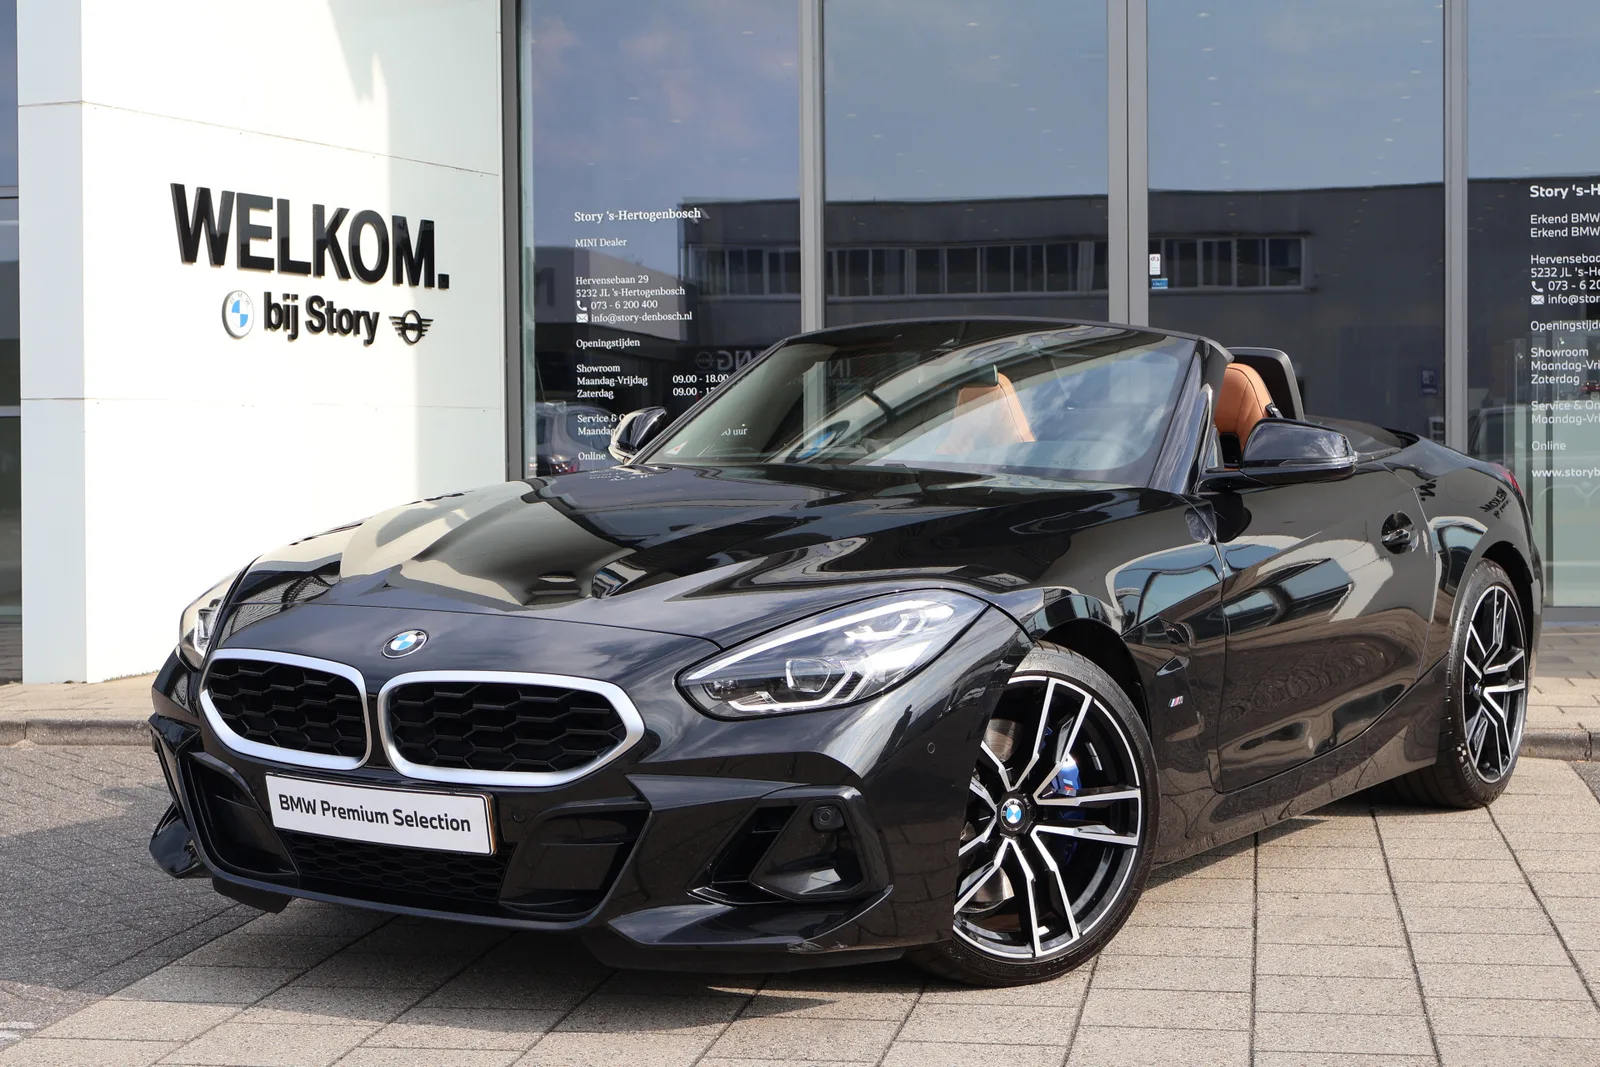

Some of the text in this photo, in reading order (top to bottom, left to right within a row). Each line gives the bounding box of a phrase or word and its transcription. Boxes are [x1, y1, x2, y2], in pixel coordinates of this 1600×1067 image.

[1529, 184, 1568, 199] Story
[574, 210, 603, 223] Story
[1530, 212, 1600, 225] Erkend BMW
[170, 183, 450, 290] WELKOM.
[1530, 226, 1600, 238] Erkend BMW
[575, 237, 628, 247] MINI Dealer
[1531, 267, 1557, 278] 5232
[1559, 267, 1572, 277] JL
[575, 275, 649, 286] Hervensebaan 29
[1548, 281, 1568, 291] 073
[1579, 280, 1586, 290] 6
[575, 289, 598, 298] 5232
[599, 289, 610, 297] JL
[590, 302, 607, 310] 073
[622, 301, 640, 309] 200
[641, 300, 658, 308] 400
[263, 291, 380, 346] bij Story
[591, 311, 693, 324] info@story-denbosch.nl
[576, 338, 641, 350] Openingstijden
[1530, 348, 1589, 358] Showroom
[576, 364, 621, 373] Showroom
[577, 376, 648, 387] Maandag-Vrijdag
[672, 374, 698, 384] 09.00
[1531, 374, 1580, 386] Zaterdag
[577, 389, 614, 400] Zaterdag
[672, 387, 698, 397] 09.00
[1531, 401, 1571, 411] Service
[1573, 400, 1582, 410] &
[577, 414, 609, 423] Service
[610, 413, 617, 422] &
[1532, 441, 1567, 451] Online
[578, 452, 606, 461] Online
[278, 793, 471, 833] BMW Premium Selection
